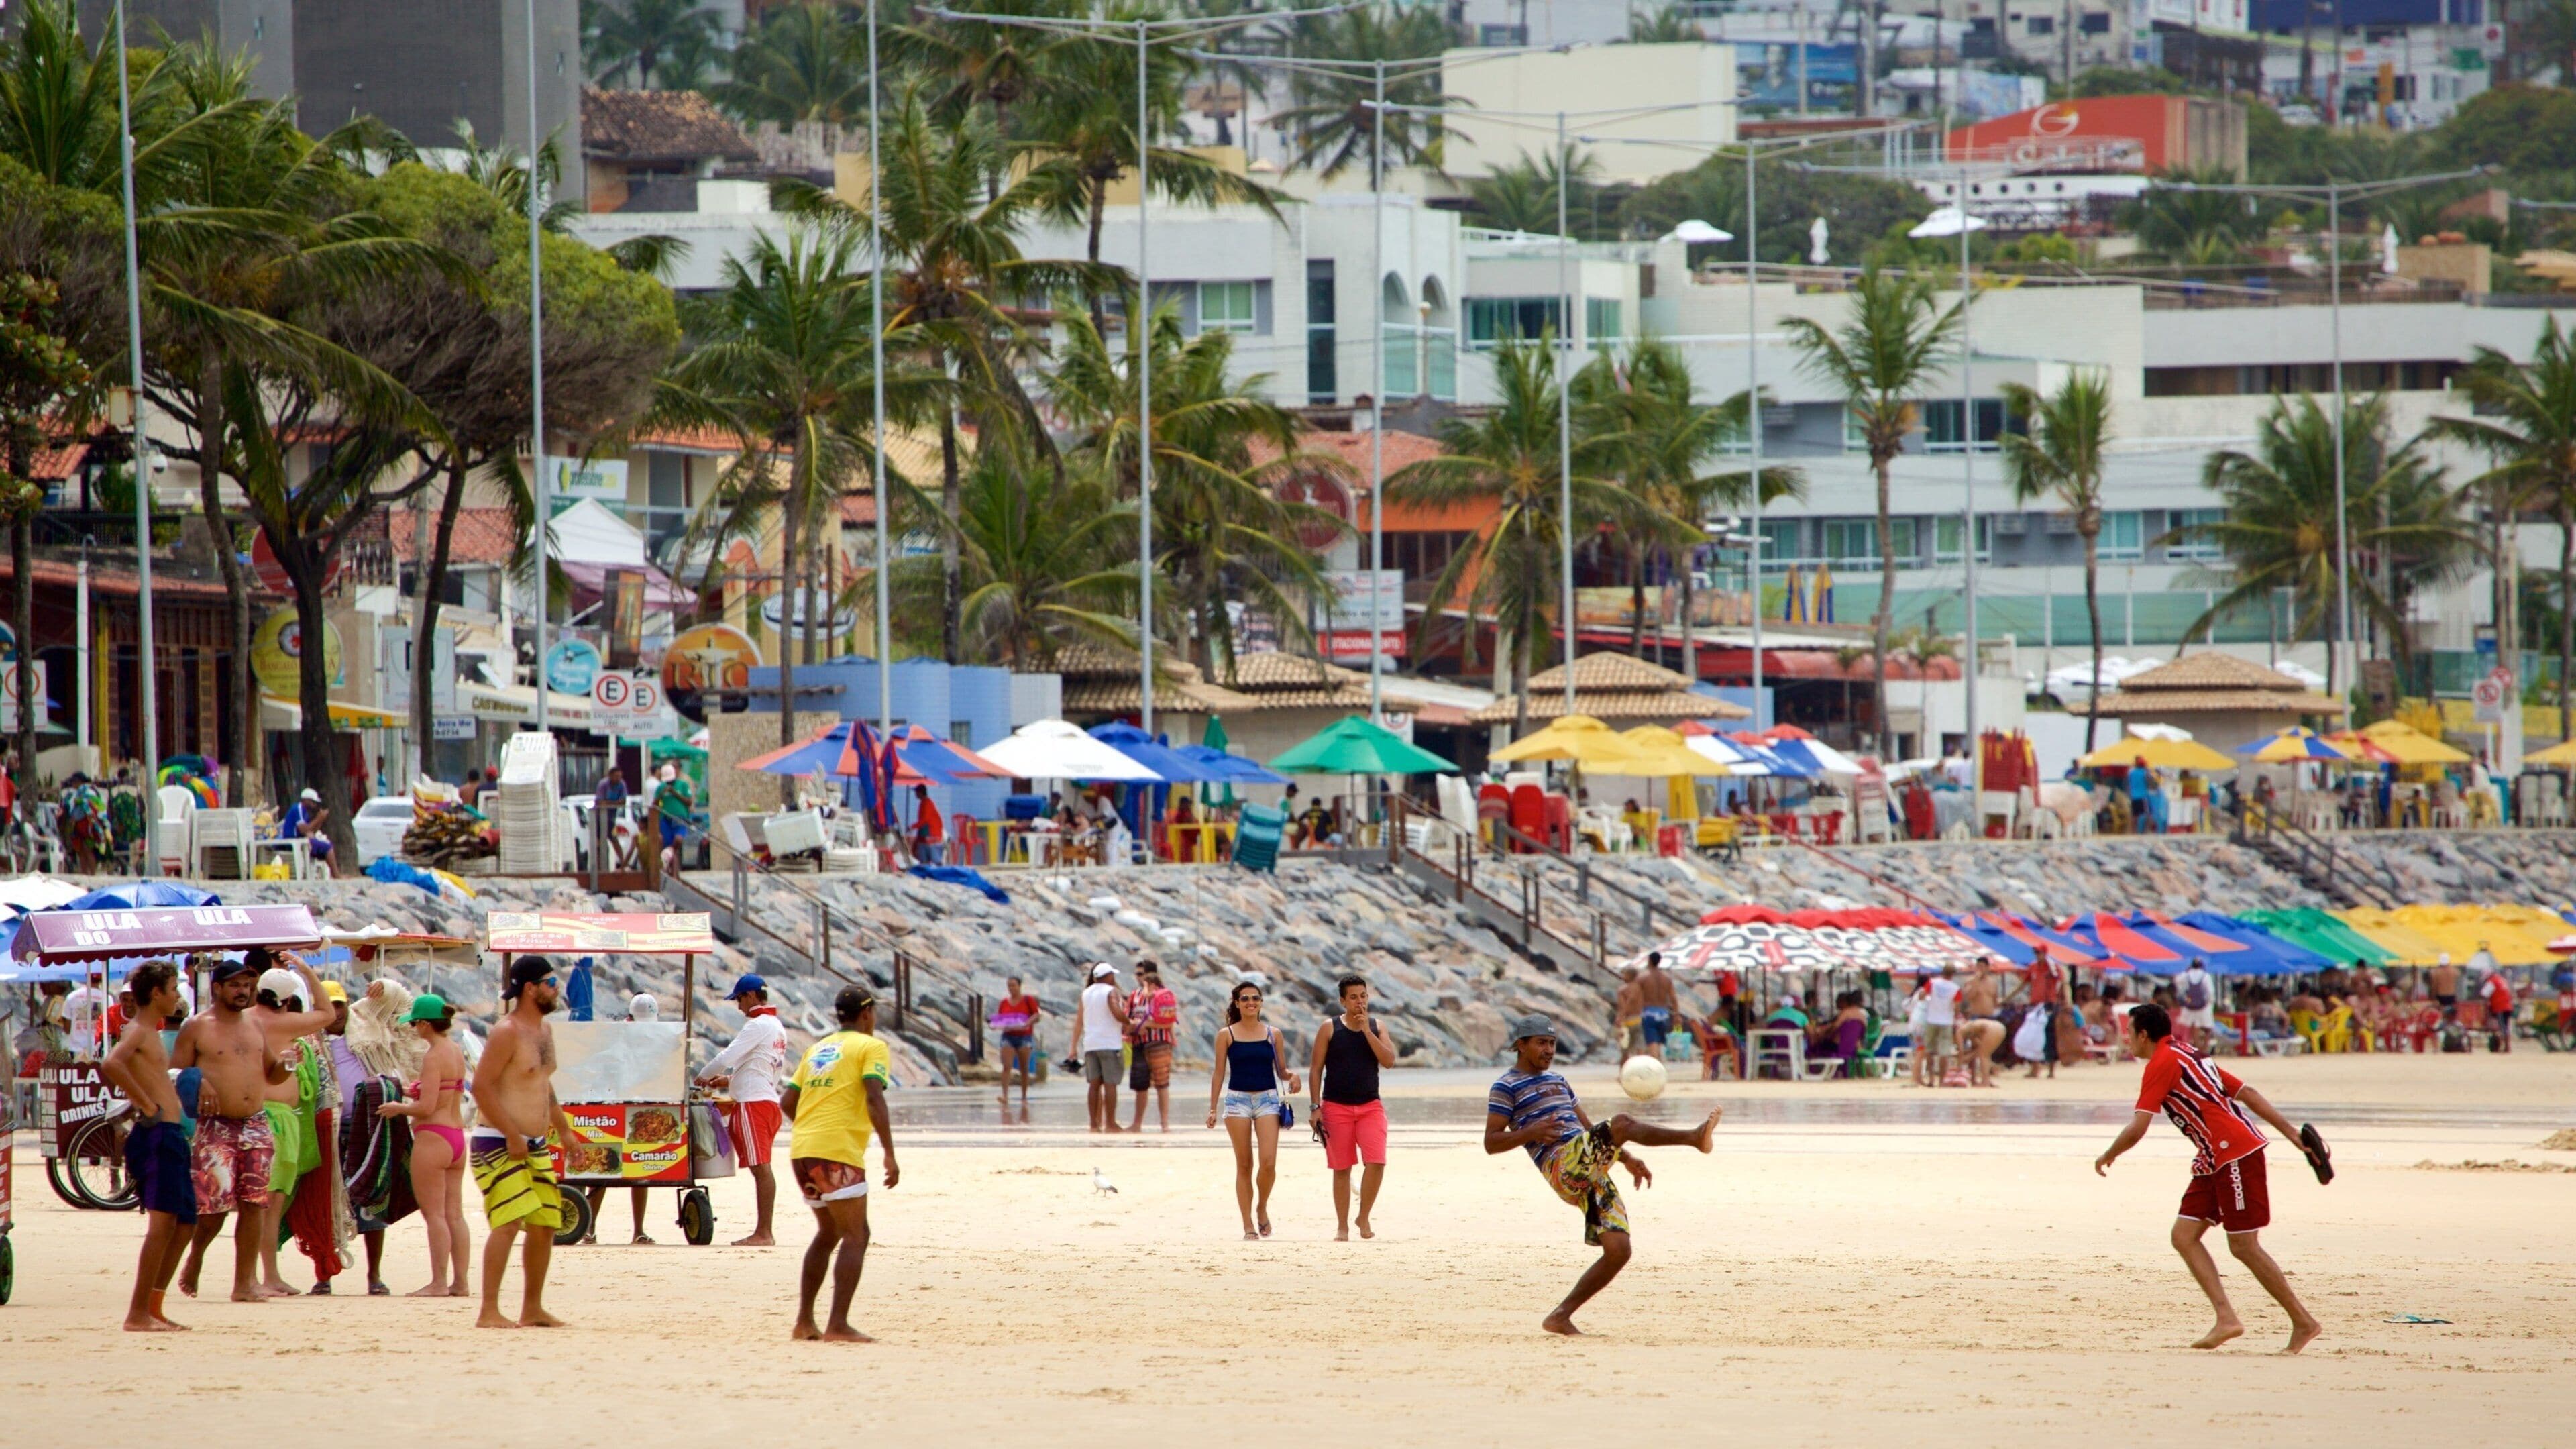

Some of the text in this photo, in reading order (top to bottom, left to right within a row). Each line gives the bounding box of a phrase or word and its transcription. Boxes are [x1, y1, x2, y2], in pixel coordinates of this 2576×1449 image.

[606, 680, 617, 700] E
[635, 688, 646, 707] E
[82, 910, 253, 930] ULA ULA
[73, 930, 111, 946] DO
[59, 1069, 101, 1084] ULA
[70, 1086, 113, 1103] ULA
[60, 1102, 106, 1124] DRINKS
[574, 1116, 617, 1127] Mistão
[586, 1130, 604, 1138] Mix
[631, 1150, 678, 1161] Camarão
[2230, 1160, 2244, 1199] adidas
